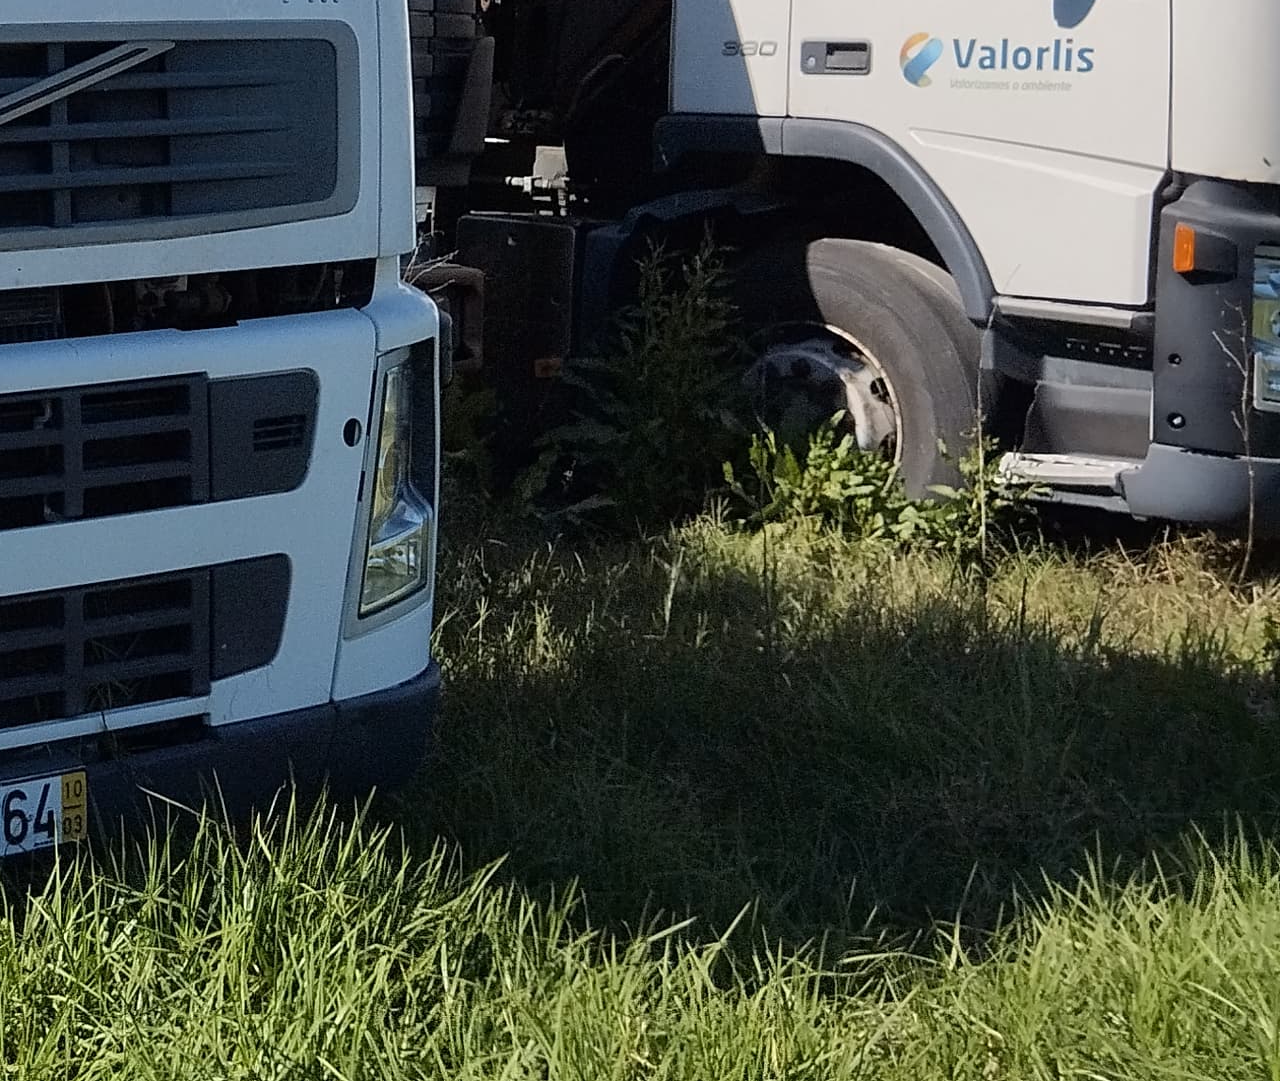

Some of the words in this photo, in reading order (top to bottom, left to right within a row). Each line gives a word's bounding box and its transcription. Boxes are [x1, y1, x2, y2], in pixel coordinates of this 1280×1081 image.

[952, 38, 1095, 73] Valorlis
[950, 79, 1010, 91] Valorizamos
[1021, 79, 1072, 92] ambiente
[64, 779, 83, 800] 10
